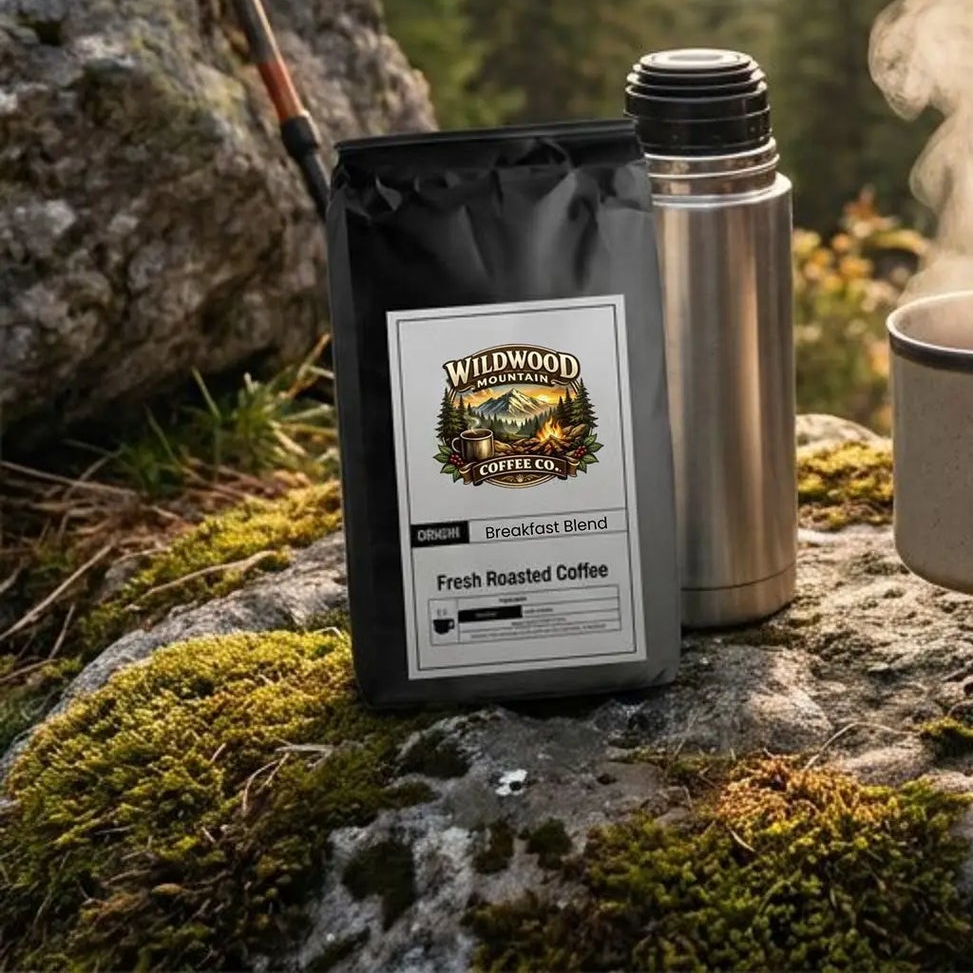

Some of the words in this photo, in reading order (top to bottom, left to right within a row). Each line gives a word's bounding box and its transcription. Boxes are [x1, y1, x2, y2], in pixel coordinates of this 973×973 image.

[445, 350, 579, 387] WILDWOOD
[477, 372, 549, 388] MOUNTAIN
[479, 459, 531, 475] COFFEE
[535, 459, 559, 472] CO.
[485, 521, 560, 539] Breakfast
[564, 517, 608, 533] Blend
[437, 572, 482, 591] Fresh
[486, 566, 552, 586] Roasted
[557, 562, 609, 581] Coffee
